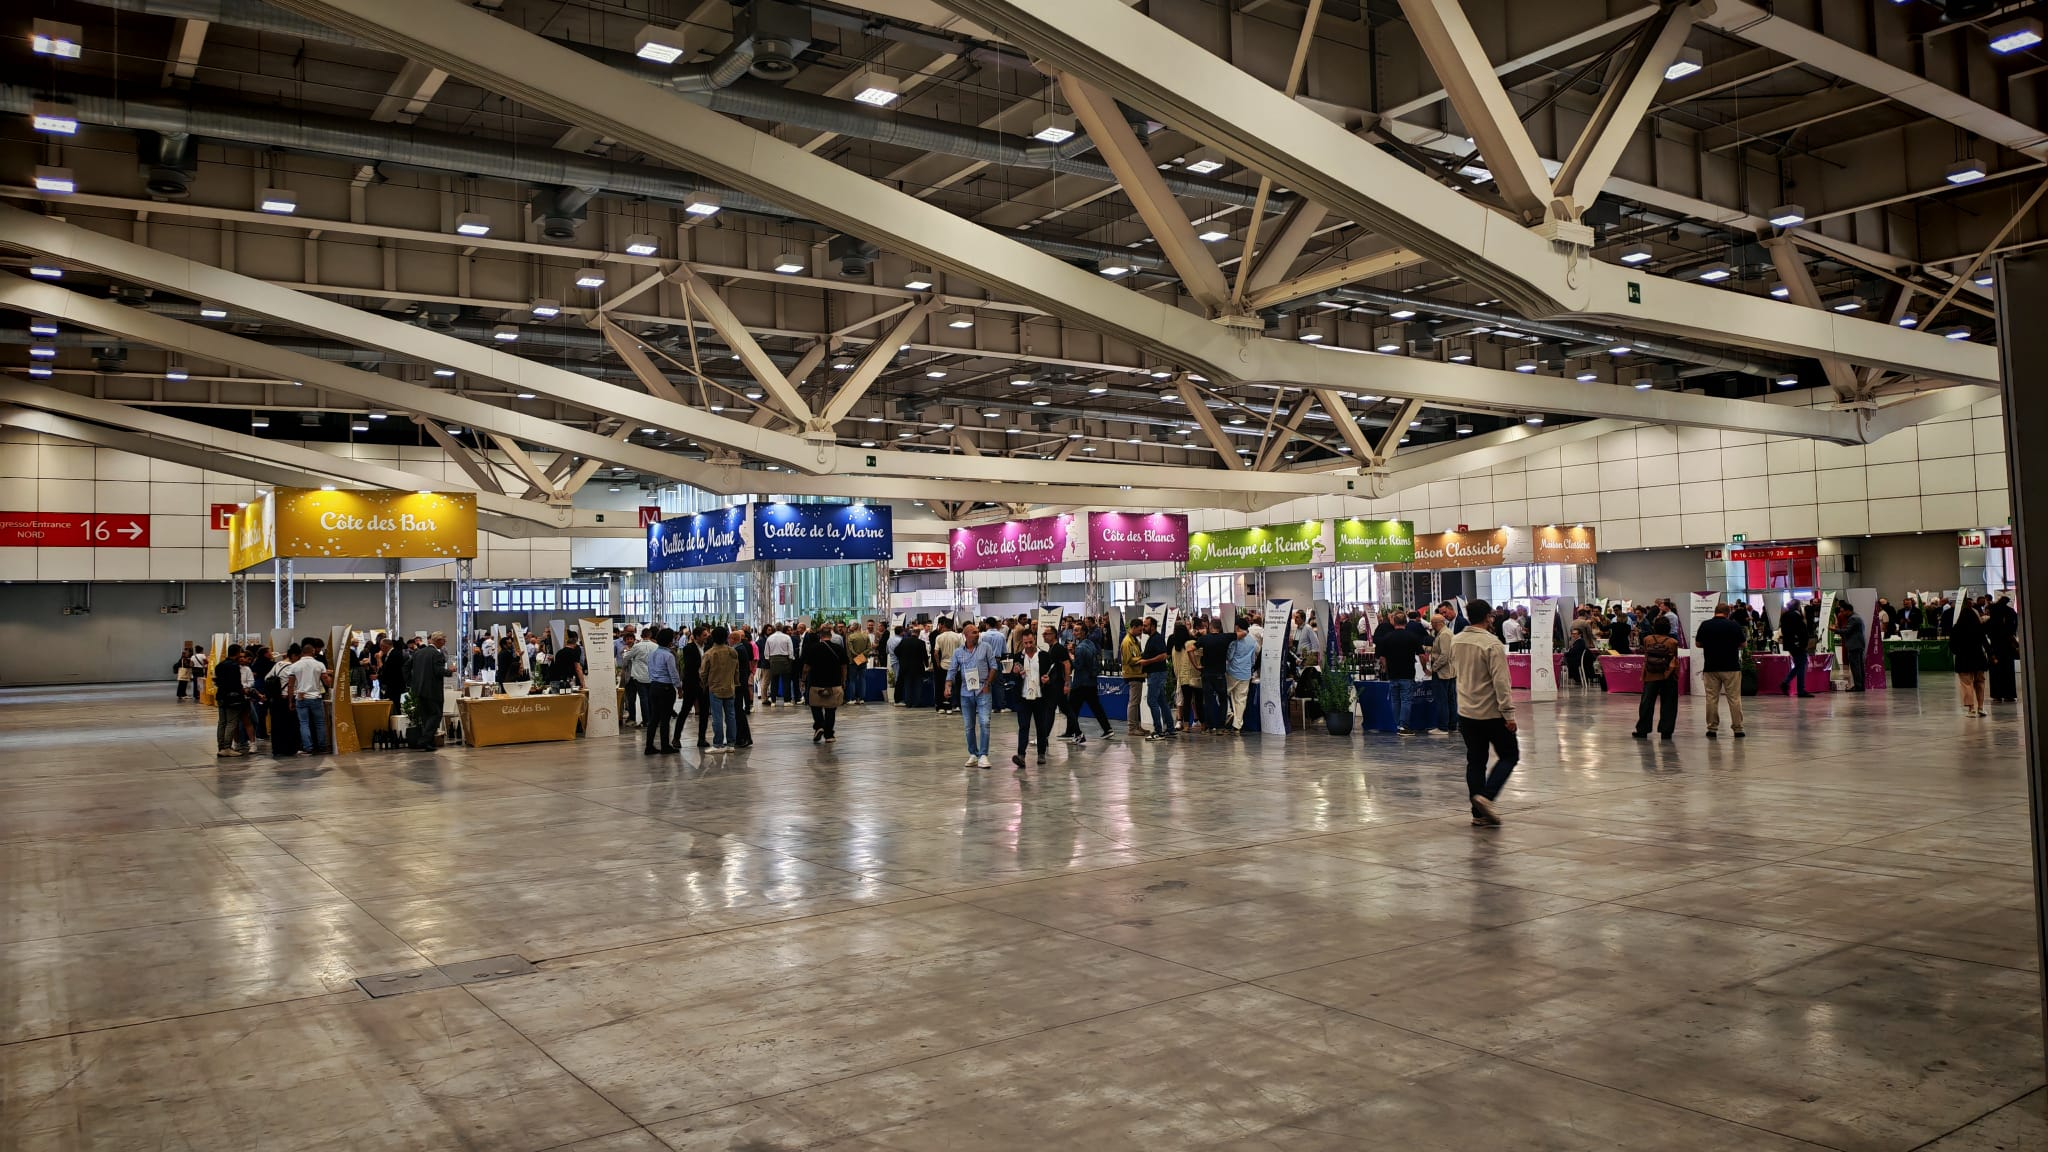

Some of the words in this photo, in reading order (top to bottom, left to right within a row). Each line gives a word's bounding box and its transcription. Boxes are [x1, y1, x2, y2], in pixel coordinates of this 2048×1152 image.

[80, 519, 110, 541] 16
[320, 511, 364, 531] Côte
[367, 515, 397, 531] des
[398, 513, 437, 532] Bar
[763, 521, 807, 538] Vallée
[809, 522, 824, 538] de
[827, 522, 840, 538] la
[840, 523, 885, 541] Marne
[17, 531, 45, 539] NORD
[661, 533, 685, 557] Vallée
[686, 531, 696, 551] de
[696, 529, 706, 550] la
[705, 527, 735, 553] Marne
[976, 537, 999, 557] Côte
[1000, 535, 1017, 555] des
[1018, 532, 1055, 552] Blancs
[1103, 528, 1125, 543] Côte
[1126, 529, 1142, 543] des
[1143, 528, 1176, 543] Blancs
[1338, 533, 1377, 548] Montagne
[1378, 533, 1388, 546] de
[1389, 533, 1412, 546] Reims
[1539, 538, 1563, 550] Maison
[1563, 538, 1591, 550] Classiche
[1204, 540, 1257, 561] Montagne
[1259, 538, 1272, 554] de
[1275, 536, 1310, 554] Reims
[1414, 544, 1443, 560] aison
[1445, 539, 1501, 558] Classiche
[501, 704, 520, 714] Côte
[521, 704, 533, 713] des
[535, 703, 551, 712] Bar
